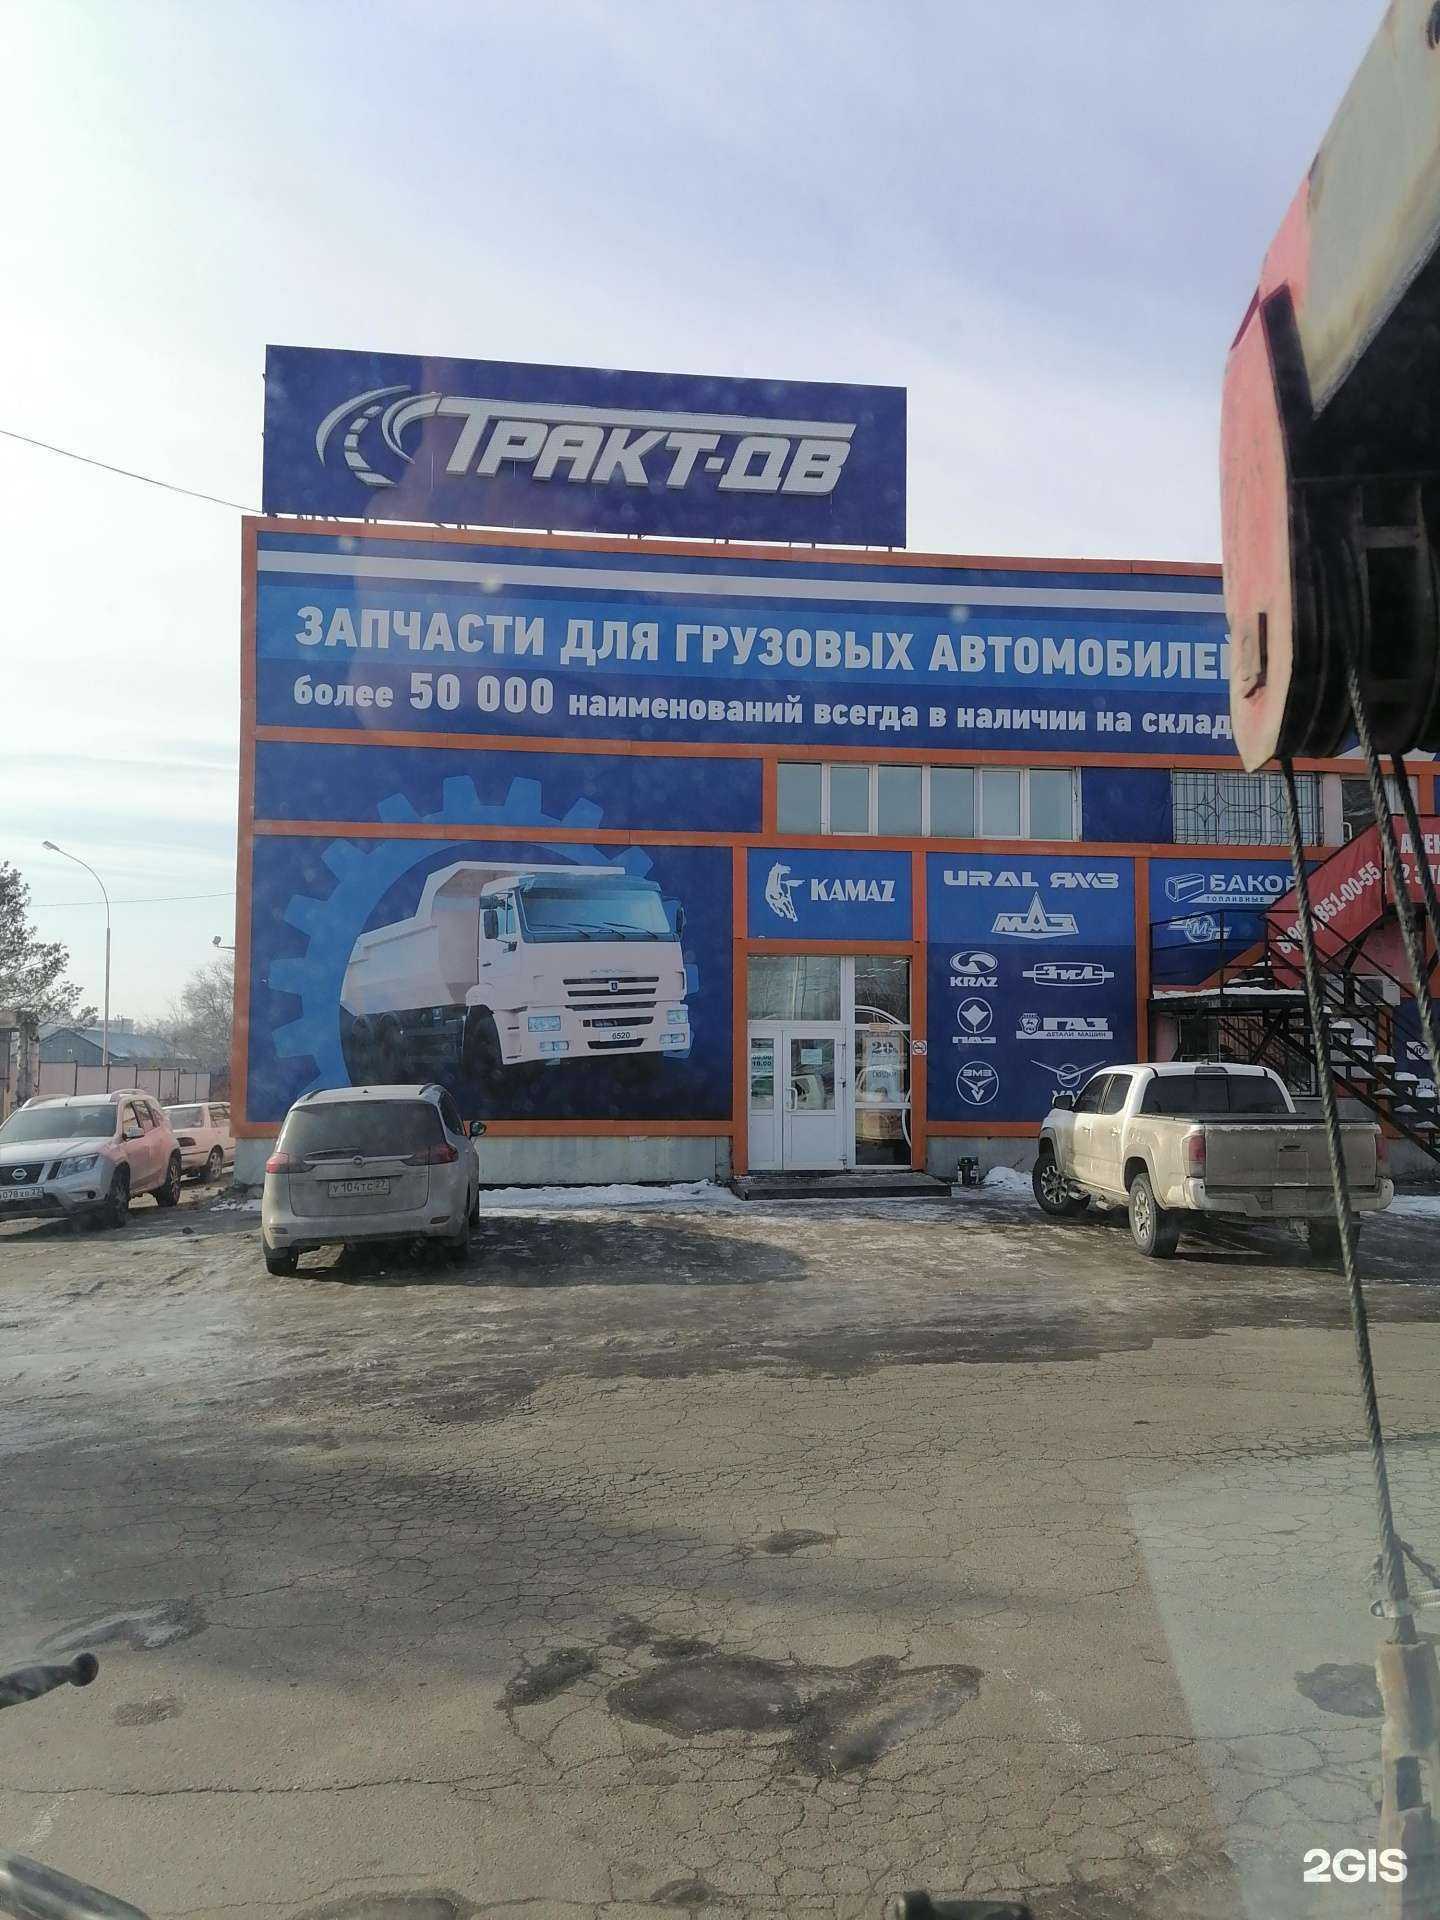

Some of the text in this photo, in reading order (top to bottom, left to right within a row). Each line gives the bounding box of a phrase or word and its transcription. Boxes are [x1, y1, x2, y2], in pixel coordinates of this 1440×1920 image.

[295, 606, 545, 656] ЗАПЧАСТИ
[560, 619, 659, 666] ДЛЯ
[675, 623, 915, 671] ГРУЗОВЫХ
[293, 672, 1233, 740] более 50 000 наименований всегда в наличии на склад
[943, 870, 1039, 887] URAL
[810, 878, 896, 902] KAMAZ
[950, 976, 998, 988] KRAZ
[1043, 1017, 1109, 1031] ГАЗ
